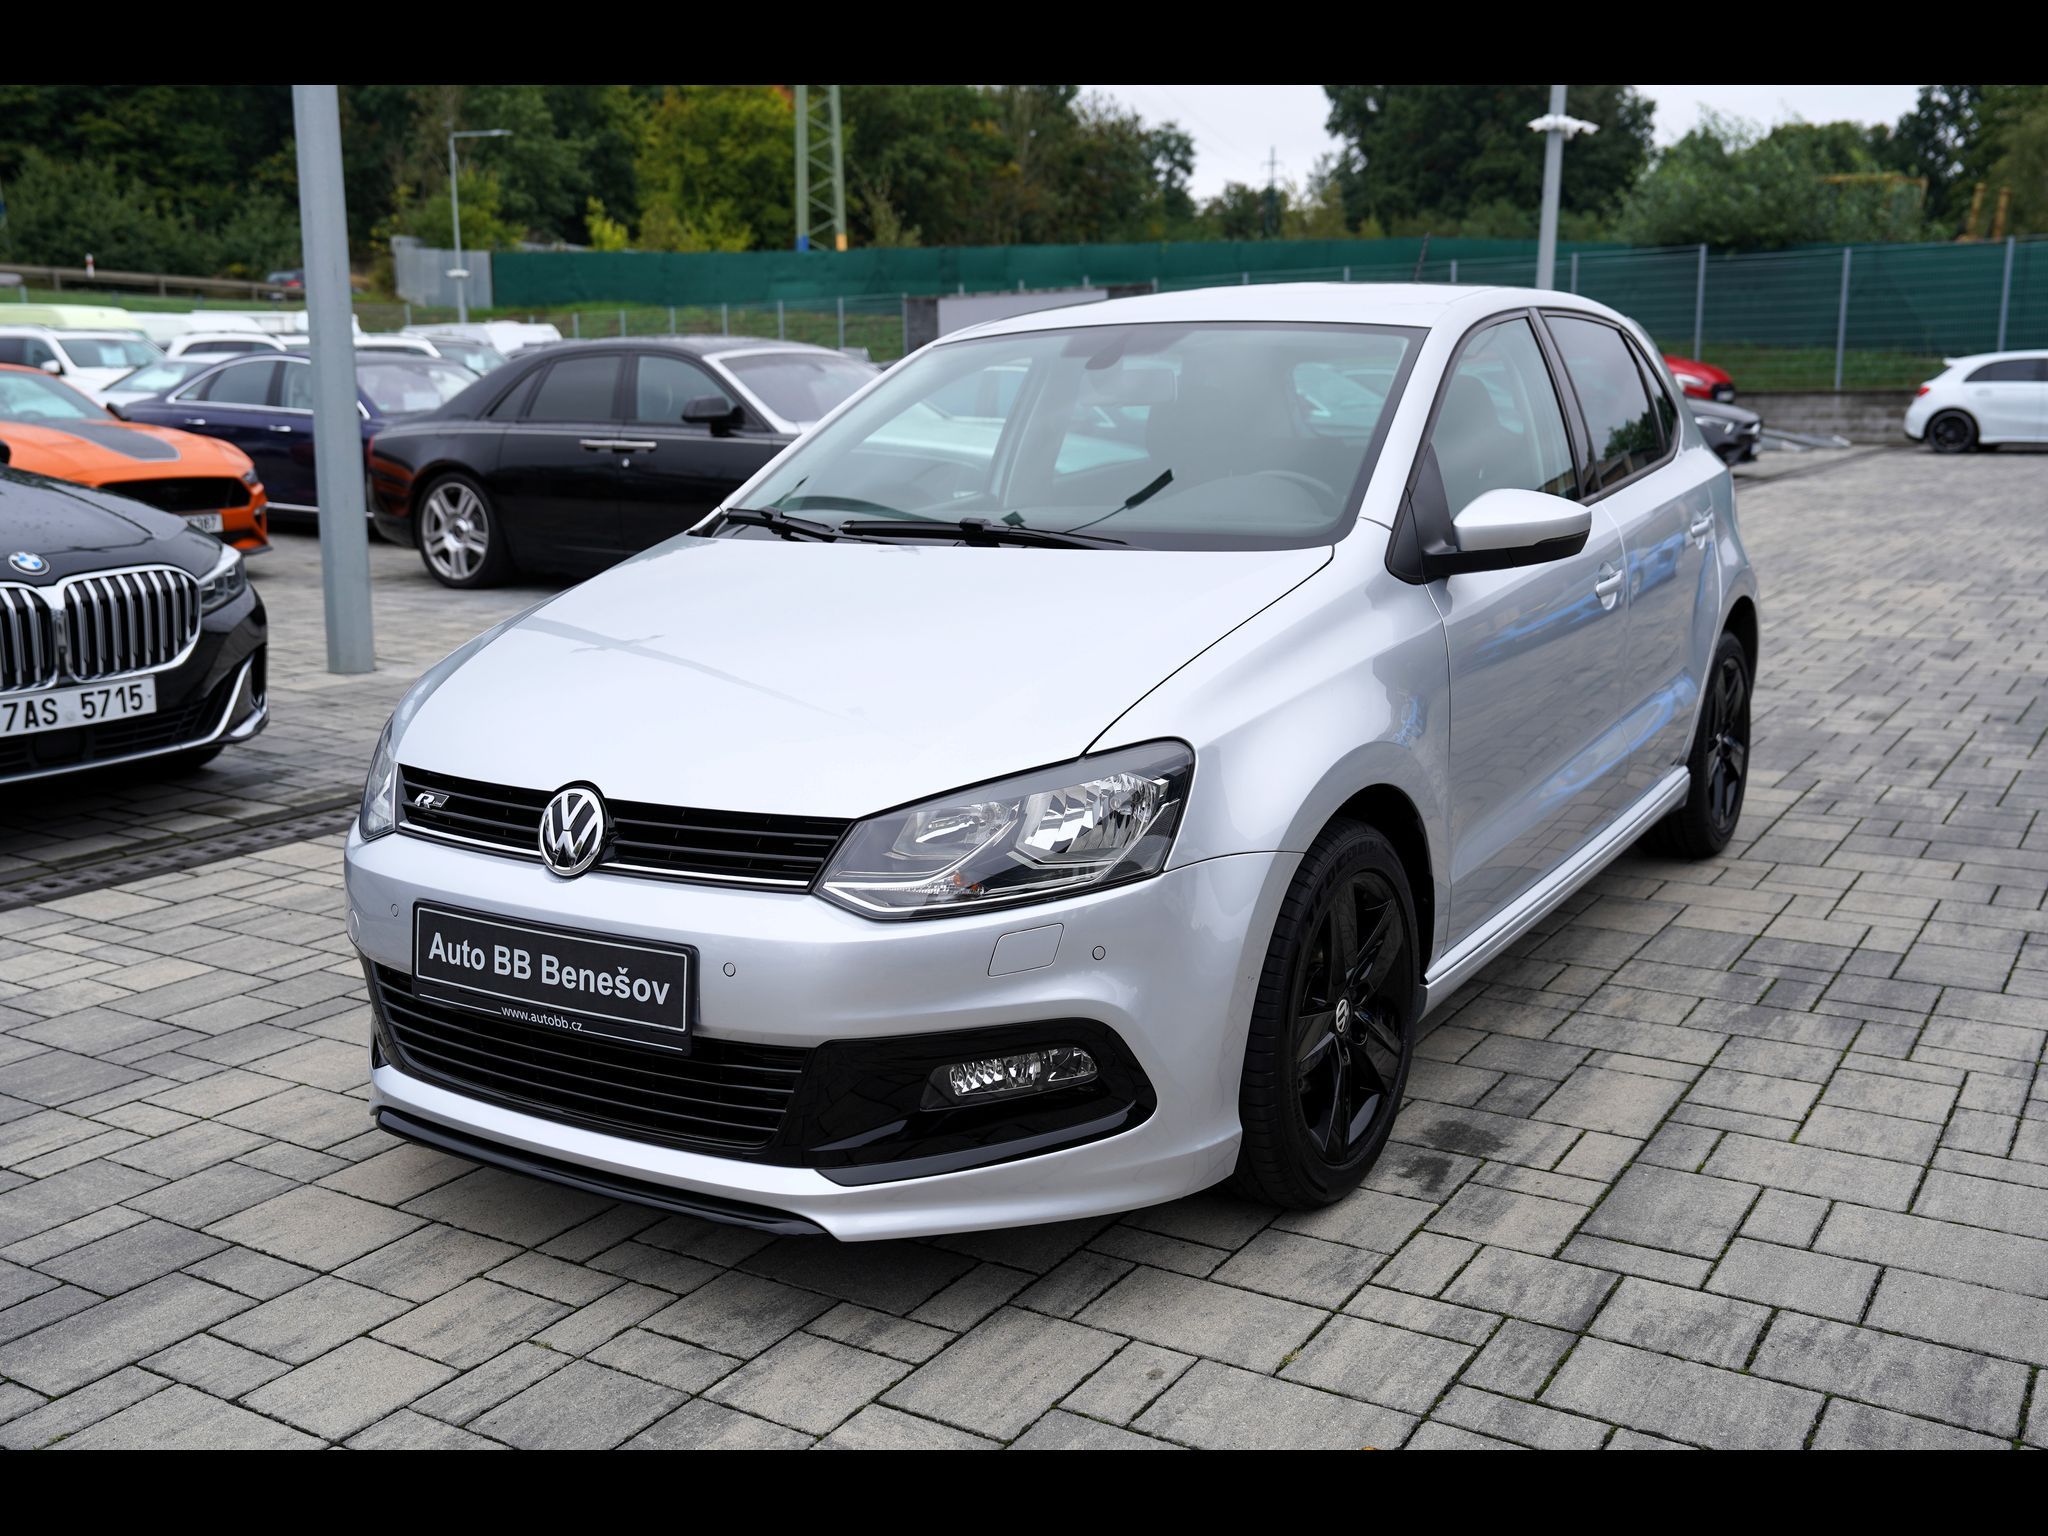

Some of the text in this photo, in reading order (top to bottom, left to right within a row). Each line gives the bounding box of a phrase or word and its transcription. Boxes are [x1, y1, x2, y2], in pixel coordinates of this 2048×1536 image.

[2, 685, 143, 732] 7AS 5715
[428, 931, 670, 1005] Auto BB Benešov
[501, 1005, 582, 1032] www.autobb.cz
